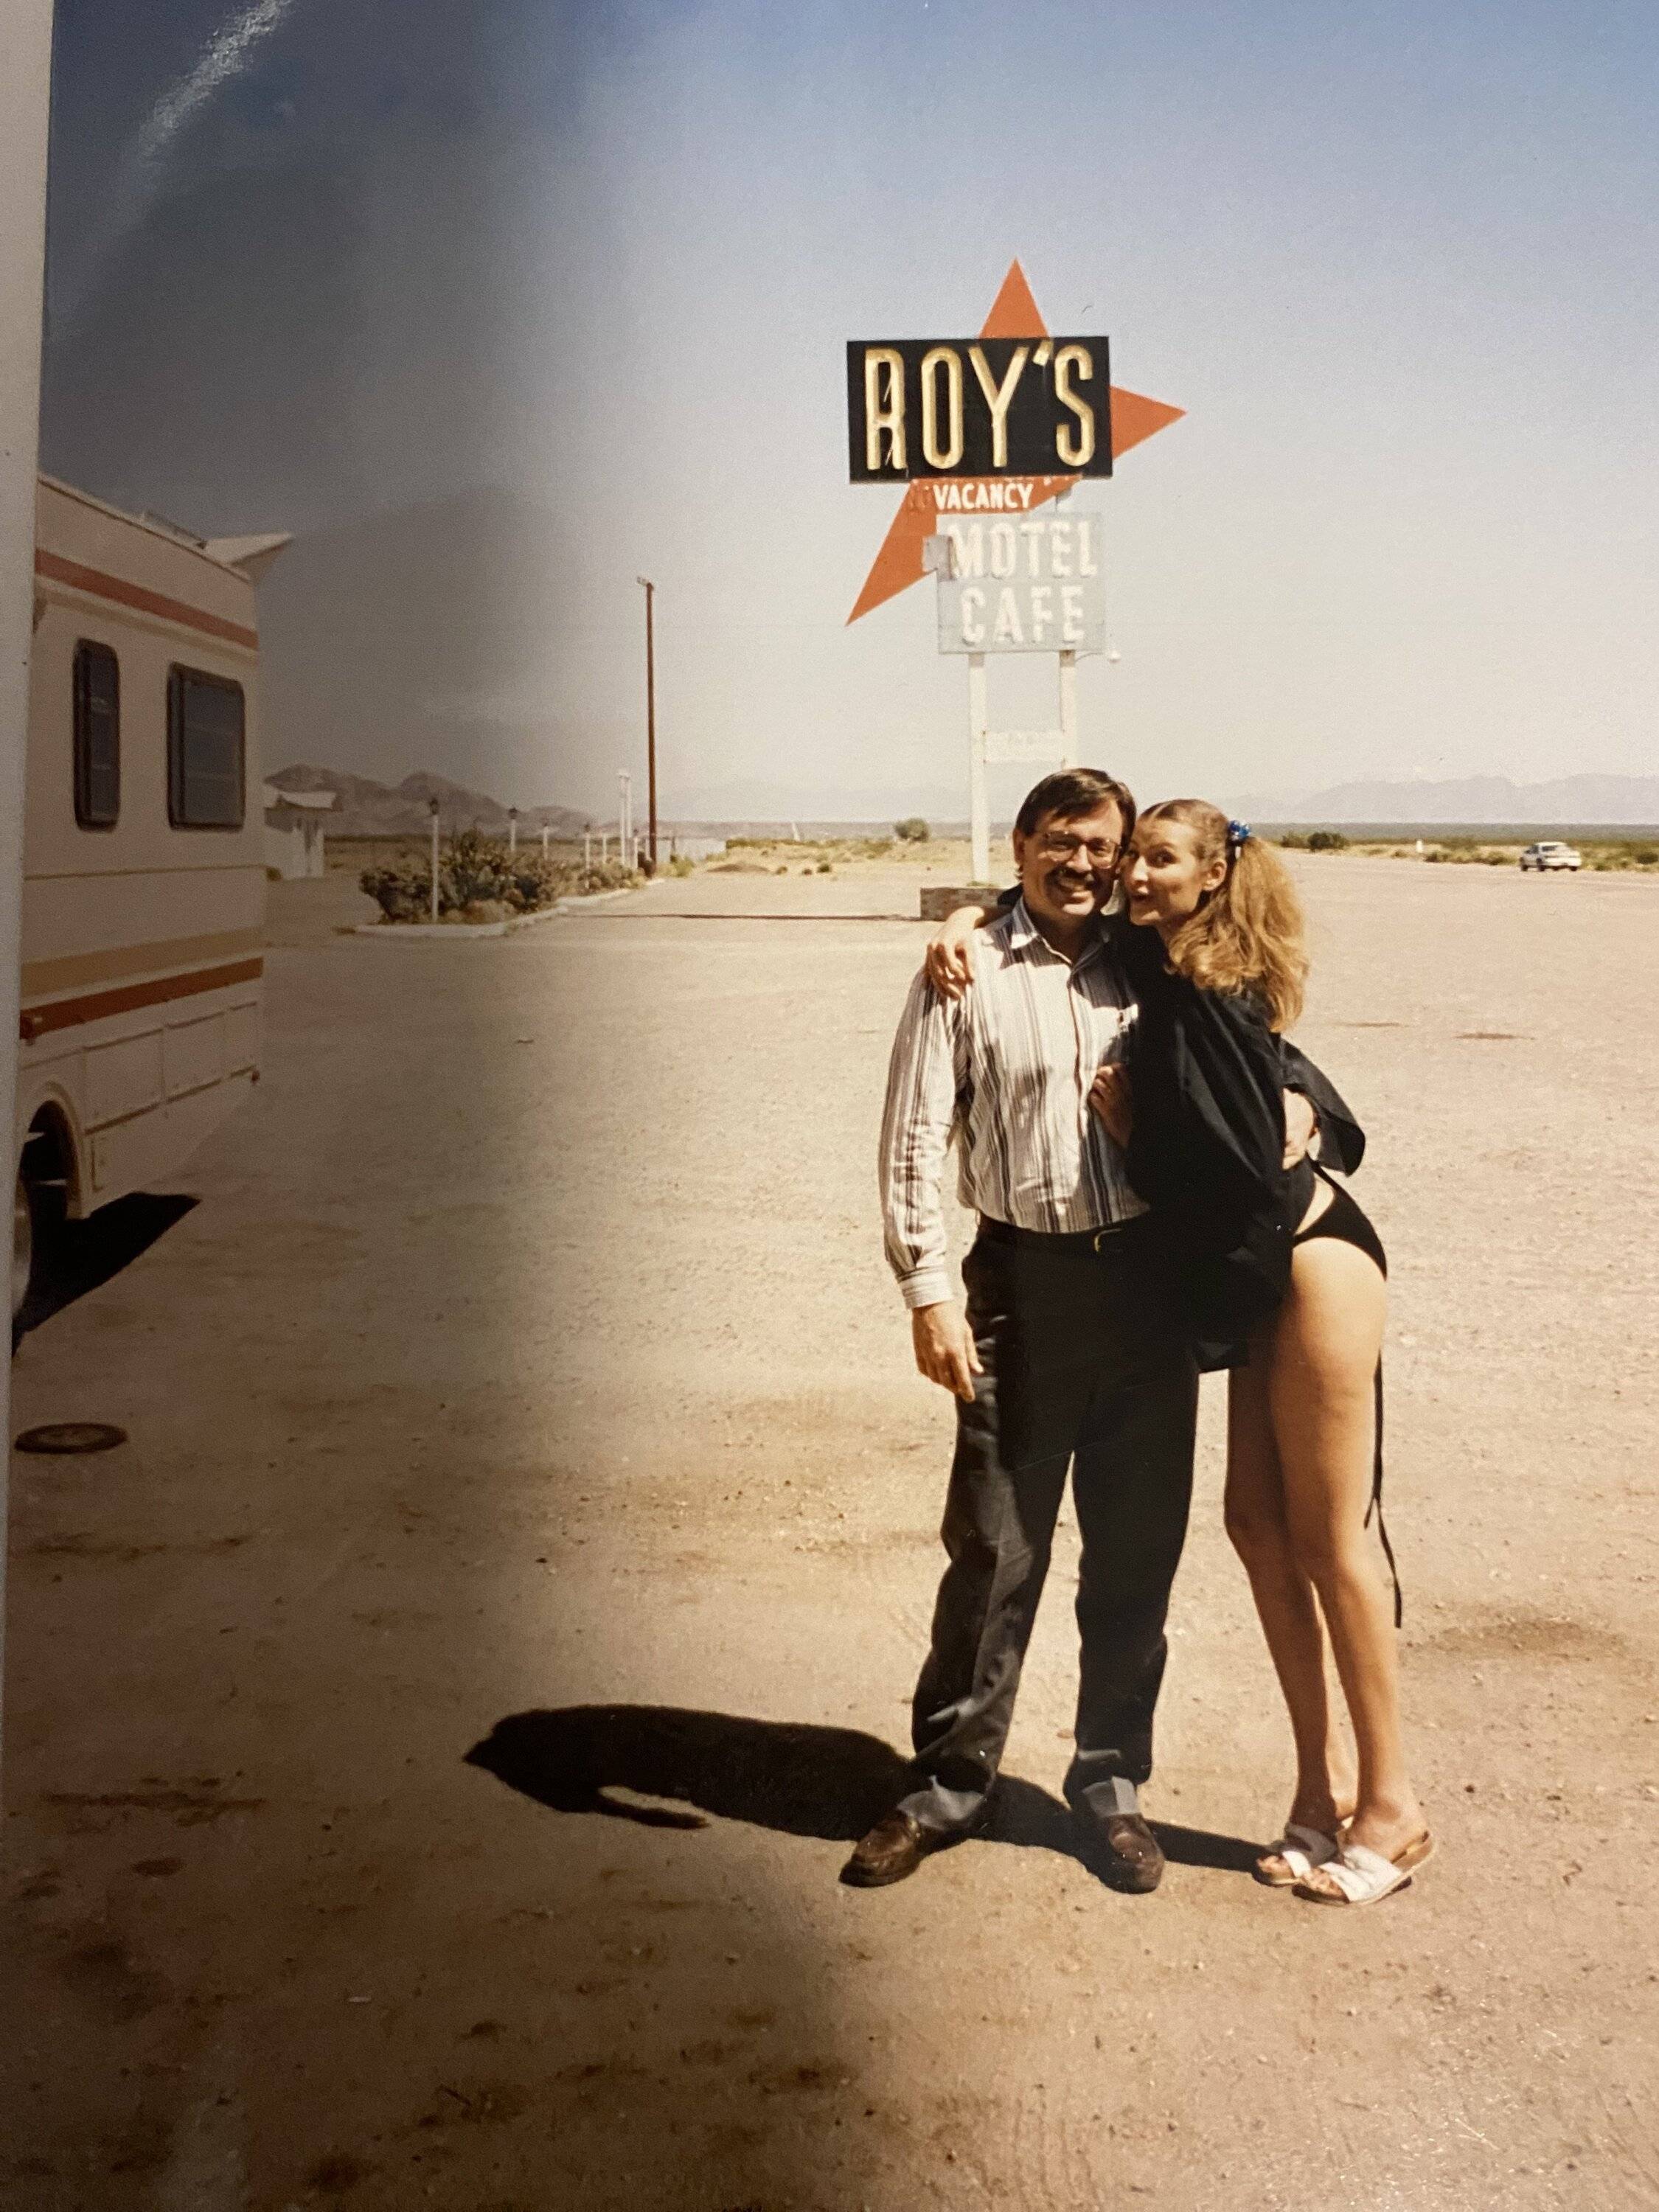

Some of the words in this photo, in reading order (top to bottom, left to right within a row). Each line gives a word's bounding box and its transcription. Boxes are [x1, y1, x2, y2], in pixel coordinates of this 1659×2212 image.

[864, 339, 1096, 470] ROY'S
[932, 483, 1034, 509] VACANCY
[947, 521, 1097, 578] MOTEL
[961, 586, 1085, 644] CAFE
